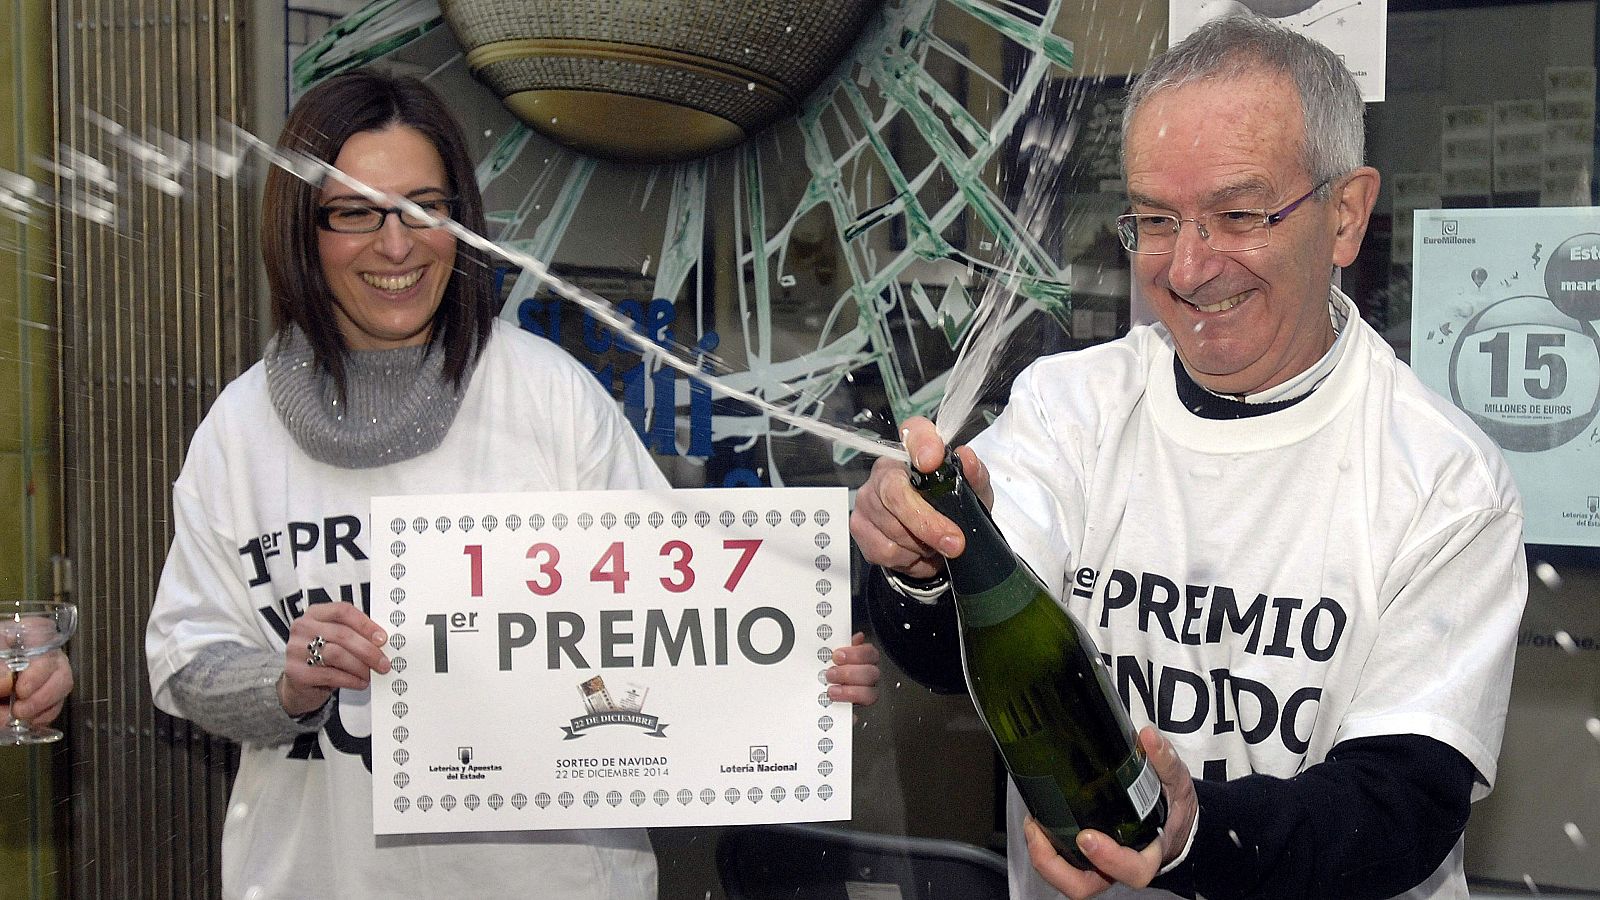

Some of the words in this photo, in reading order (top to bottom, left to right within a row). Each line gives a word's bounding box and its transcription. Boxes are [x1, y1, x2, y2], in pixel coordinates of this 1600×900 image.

[1423, 237, 1476, 245] EuroMillones
[1479, 332, 1567, 400] 15
[1484, 403, 1527, 414] MILLONES
[1529, 404, 1541, 414] DE
[1543, 405, 1572, 415] EUROS
[287, 515, 371, 570] PR
[1099, 568, 1348, 662] PREMIO
[424, 609, 479, 674] 1er
[497, 606, 796, 671] PREMIO
[574, 721, 585, 729] 22
[585, 717, 600, 725] DE
[600, 714, 655, 727] DICIEMBRE
[556, 759, 598, 768] SORTEO
[602, 758, 616, 767] DE
[618, 757, 667, 767] NAVIDAD
[757, 763, 798, 773] Nacional
[467, 765, 502, 773] Apuestas
[556, 770, 568, 779] 22
[571, 770, 584, 779] DE
[587, 769, 640, 778] DICIEMBRE
[643, 768, 669, 777] 2014
